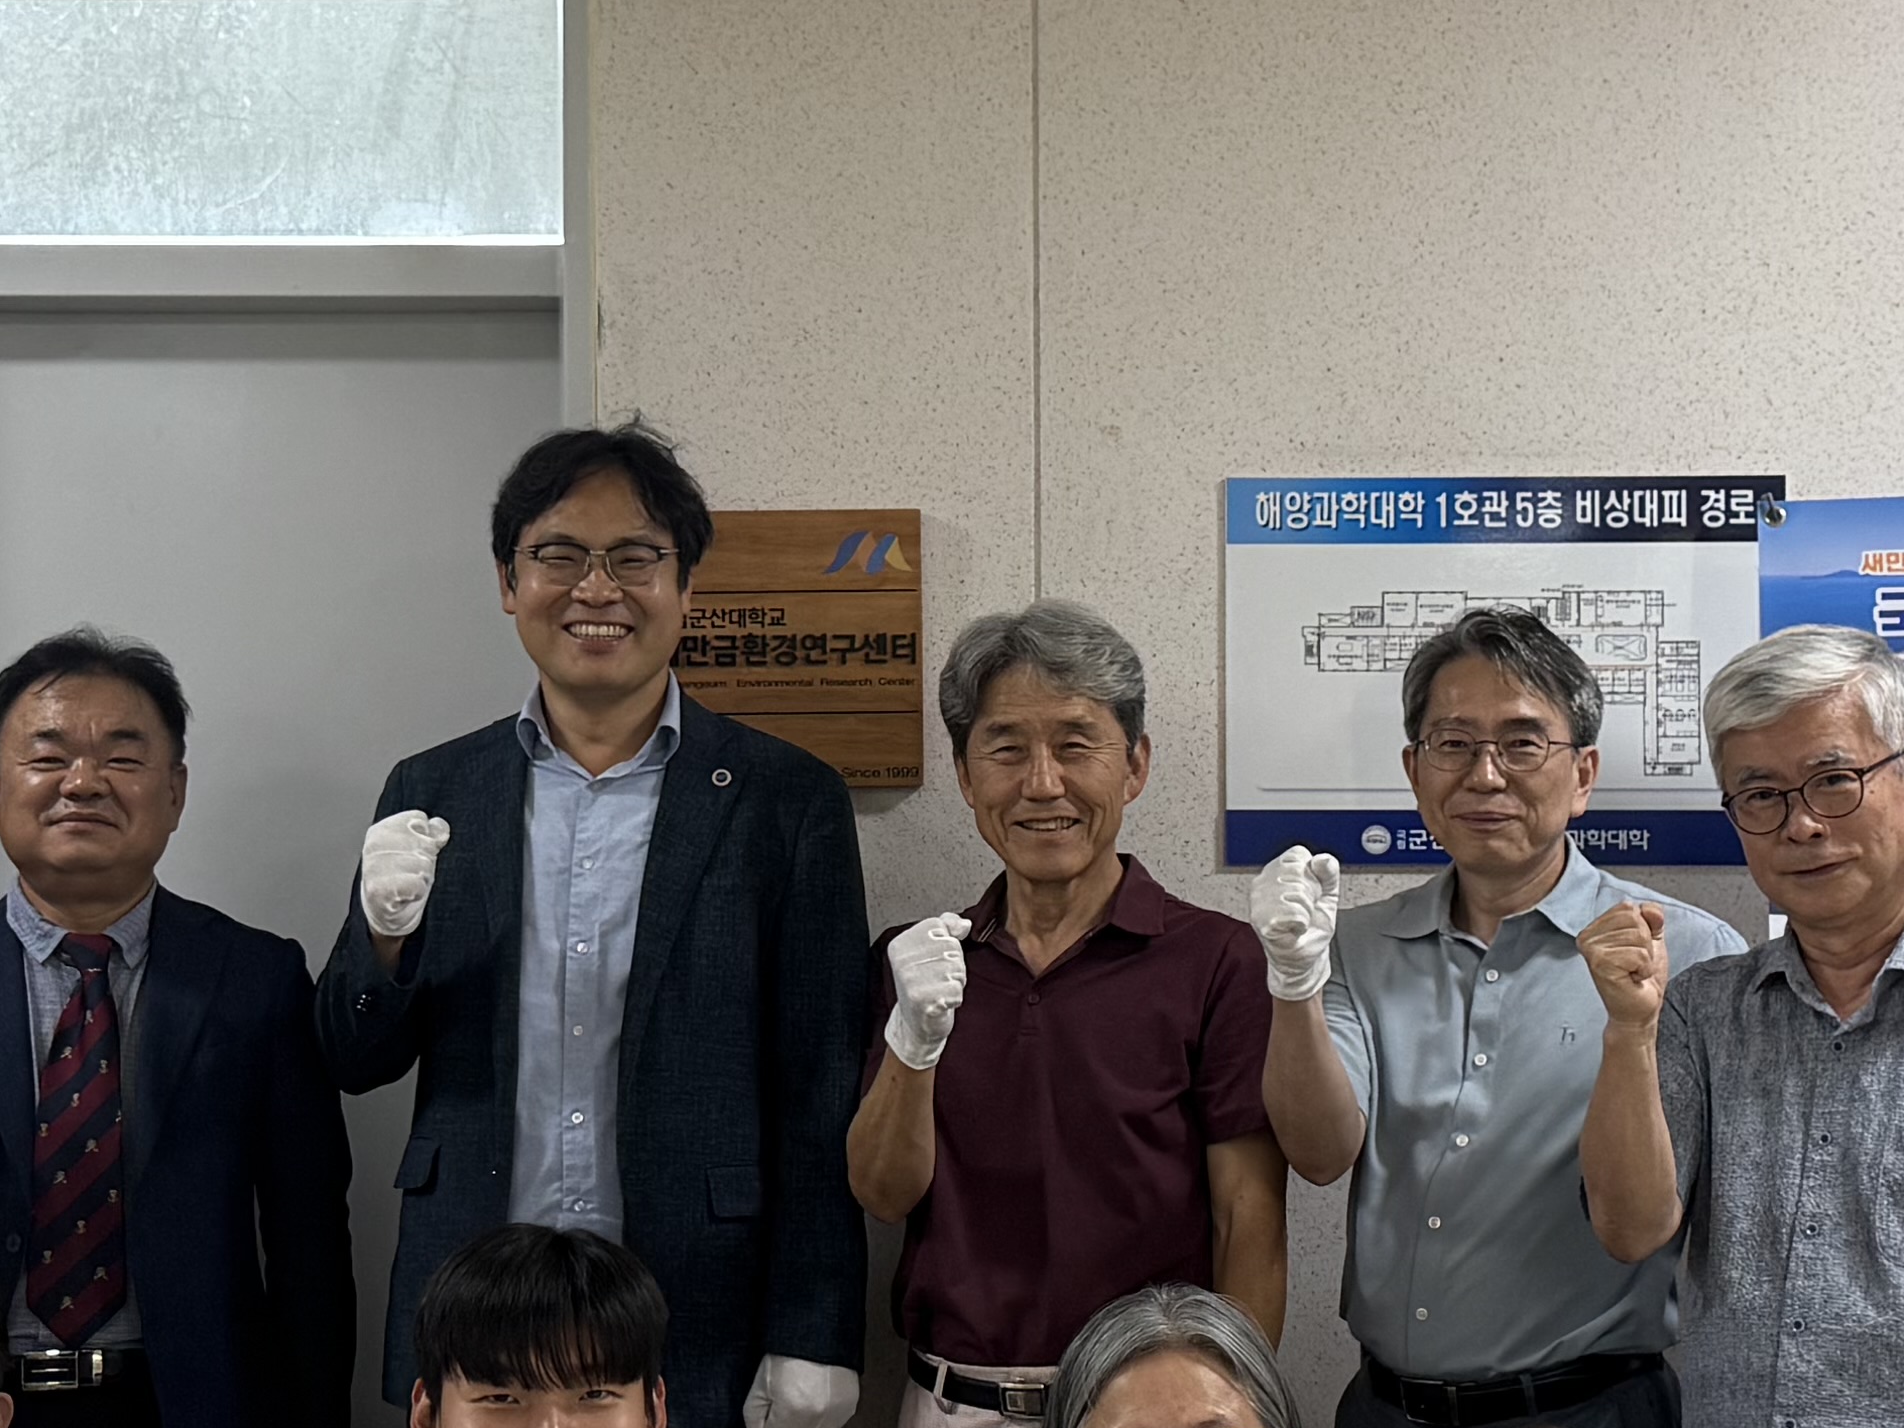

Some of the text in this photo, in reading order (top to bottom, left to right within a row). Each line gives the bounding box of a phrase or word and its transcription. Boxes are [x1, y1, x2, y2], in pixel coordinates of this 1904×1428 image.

[1255, 489, 1756, 529] 해양과학대학 1호관 5층 비상대피 경로
[682, 606, 787, 629] 군산대학교
[670, 632, 917, 667] 만금환경연구센터
